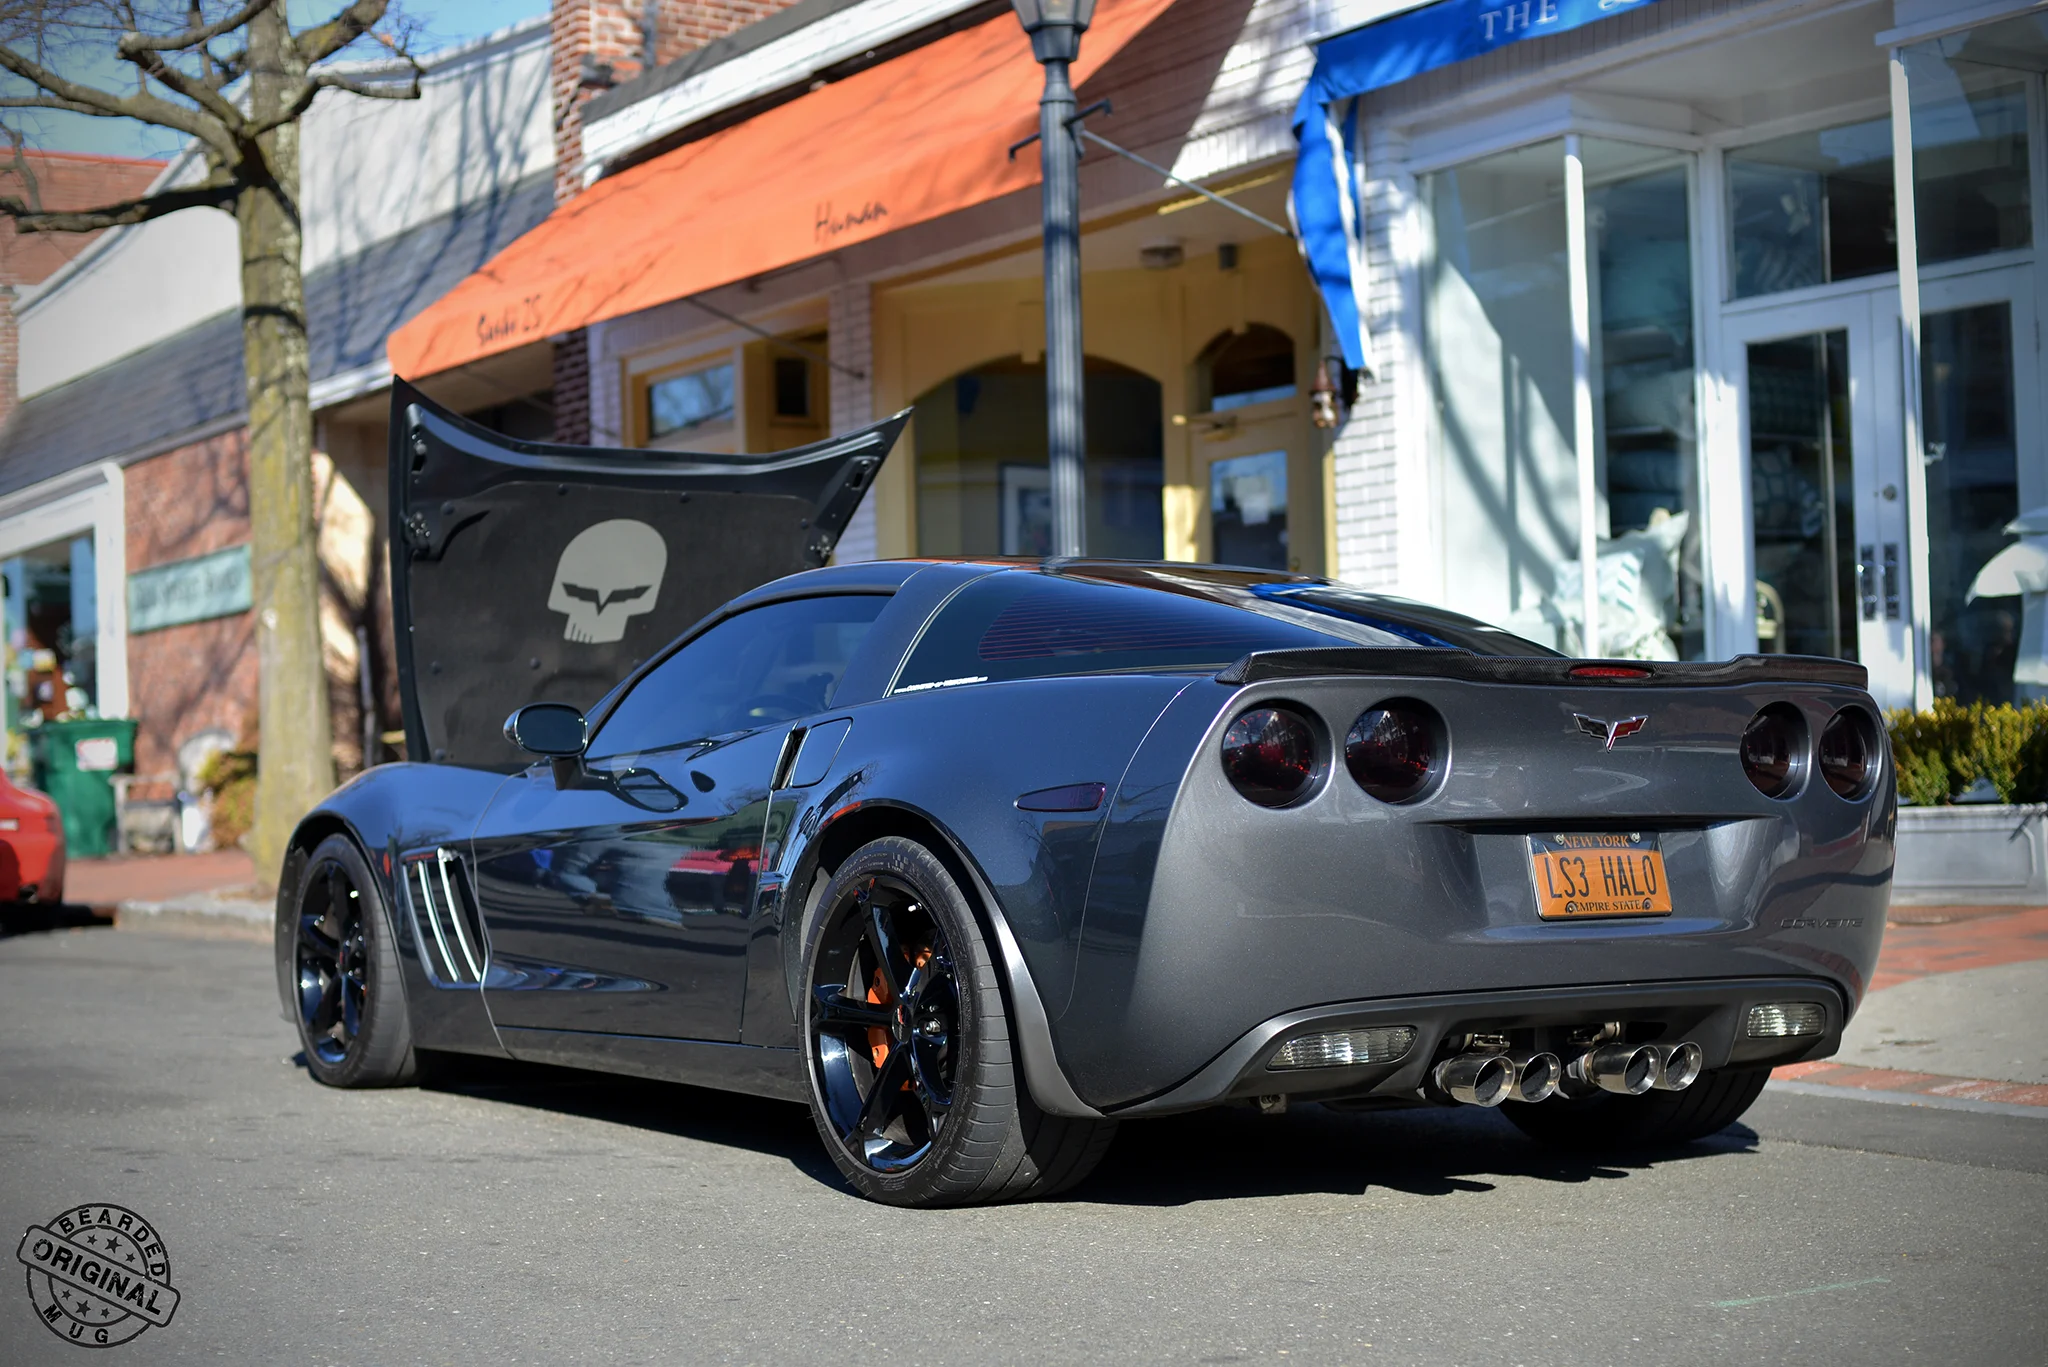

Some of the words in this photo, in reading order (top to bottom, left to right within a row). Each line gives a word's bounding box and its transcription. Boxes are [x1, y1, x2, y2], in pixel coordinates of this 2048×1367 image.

[1479, 0, 1559, 41] THE
[1563, 836, 1596, 849] NEW
[1597, 835, 1630, 848] YORK
[1544, 856, 1590, 899] LS3
[1599, 855, 1657, 897] HALO
[1575, 902, 1610, 912] EMPIRE
[1612, 900, 1642, 911] STATE
[1780, 918, 1864, 929] CORVETTE
